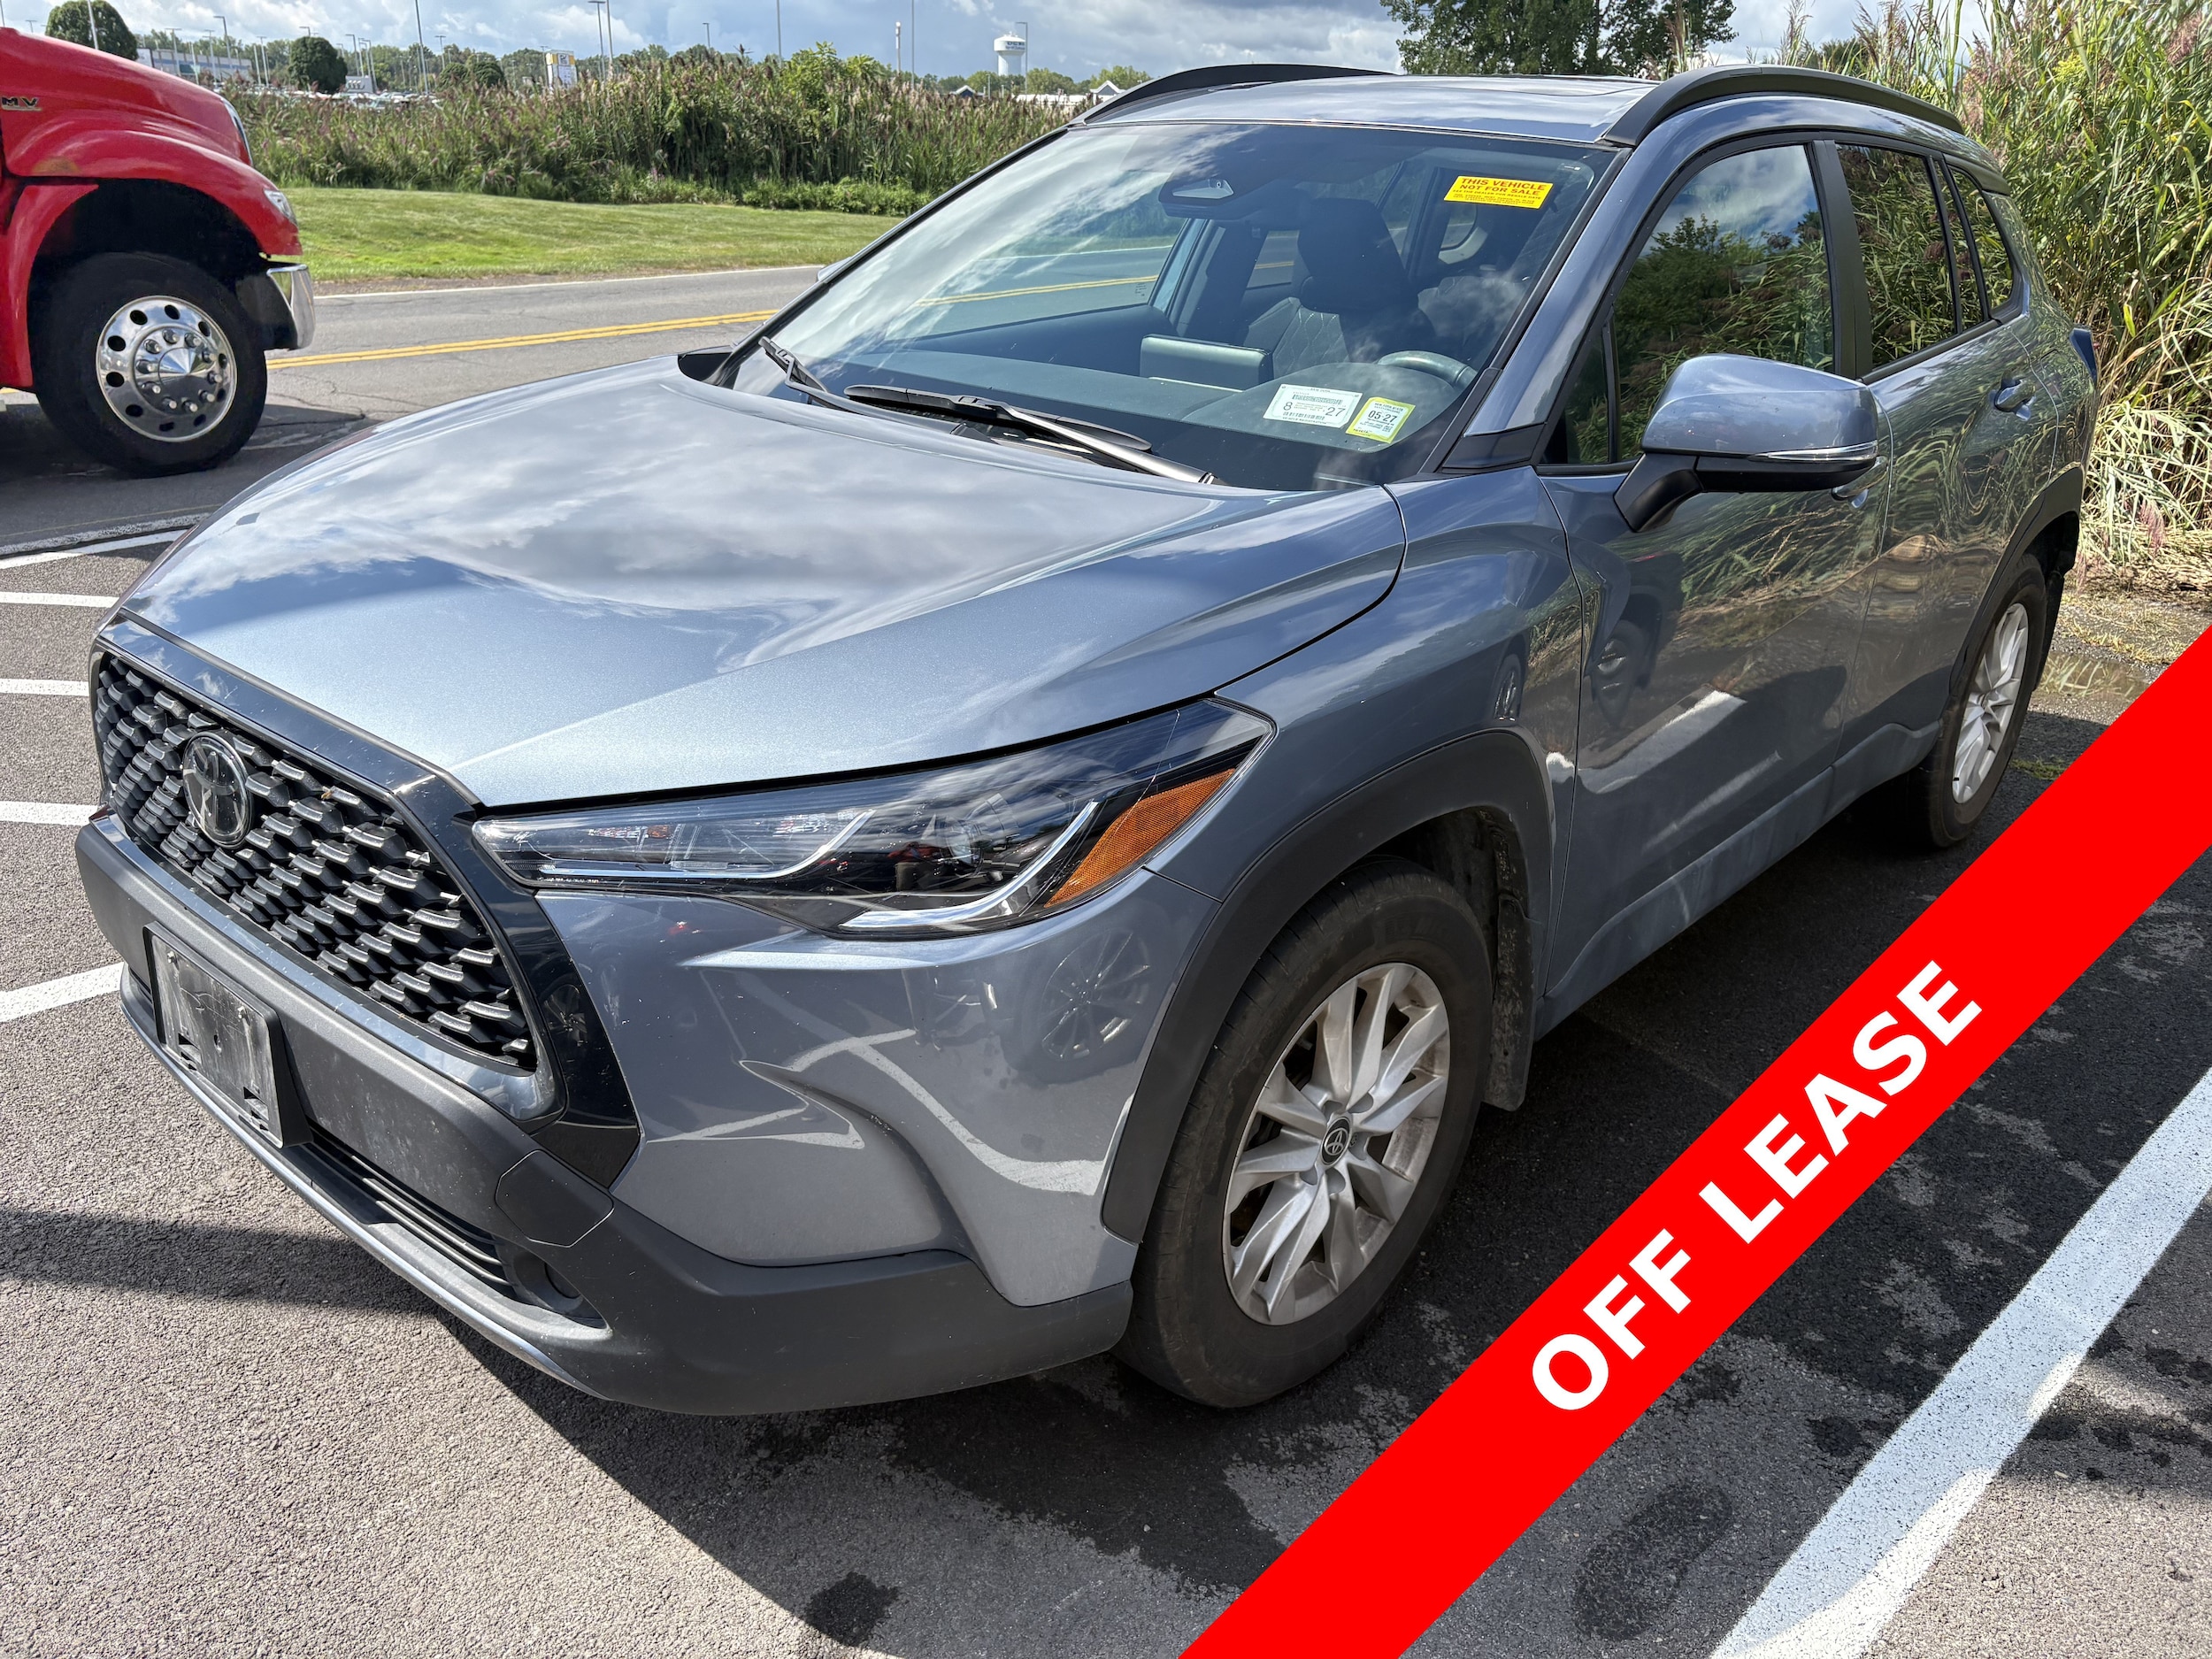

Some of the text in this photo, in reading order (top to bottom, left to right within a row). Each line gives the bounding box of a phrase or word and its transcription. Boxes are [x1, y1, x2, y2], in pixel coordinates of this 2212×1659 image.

[1, 96, 39, 107] MV
[1493, 180, 1548, 191] VEHICLE
[1283, 401, 1294, 411] 8
[1325, 406, 1346, 417] 27
